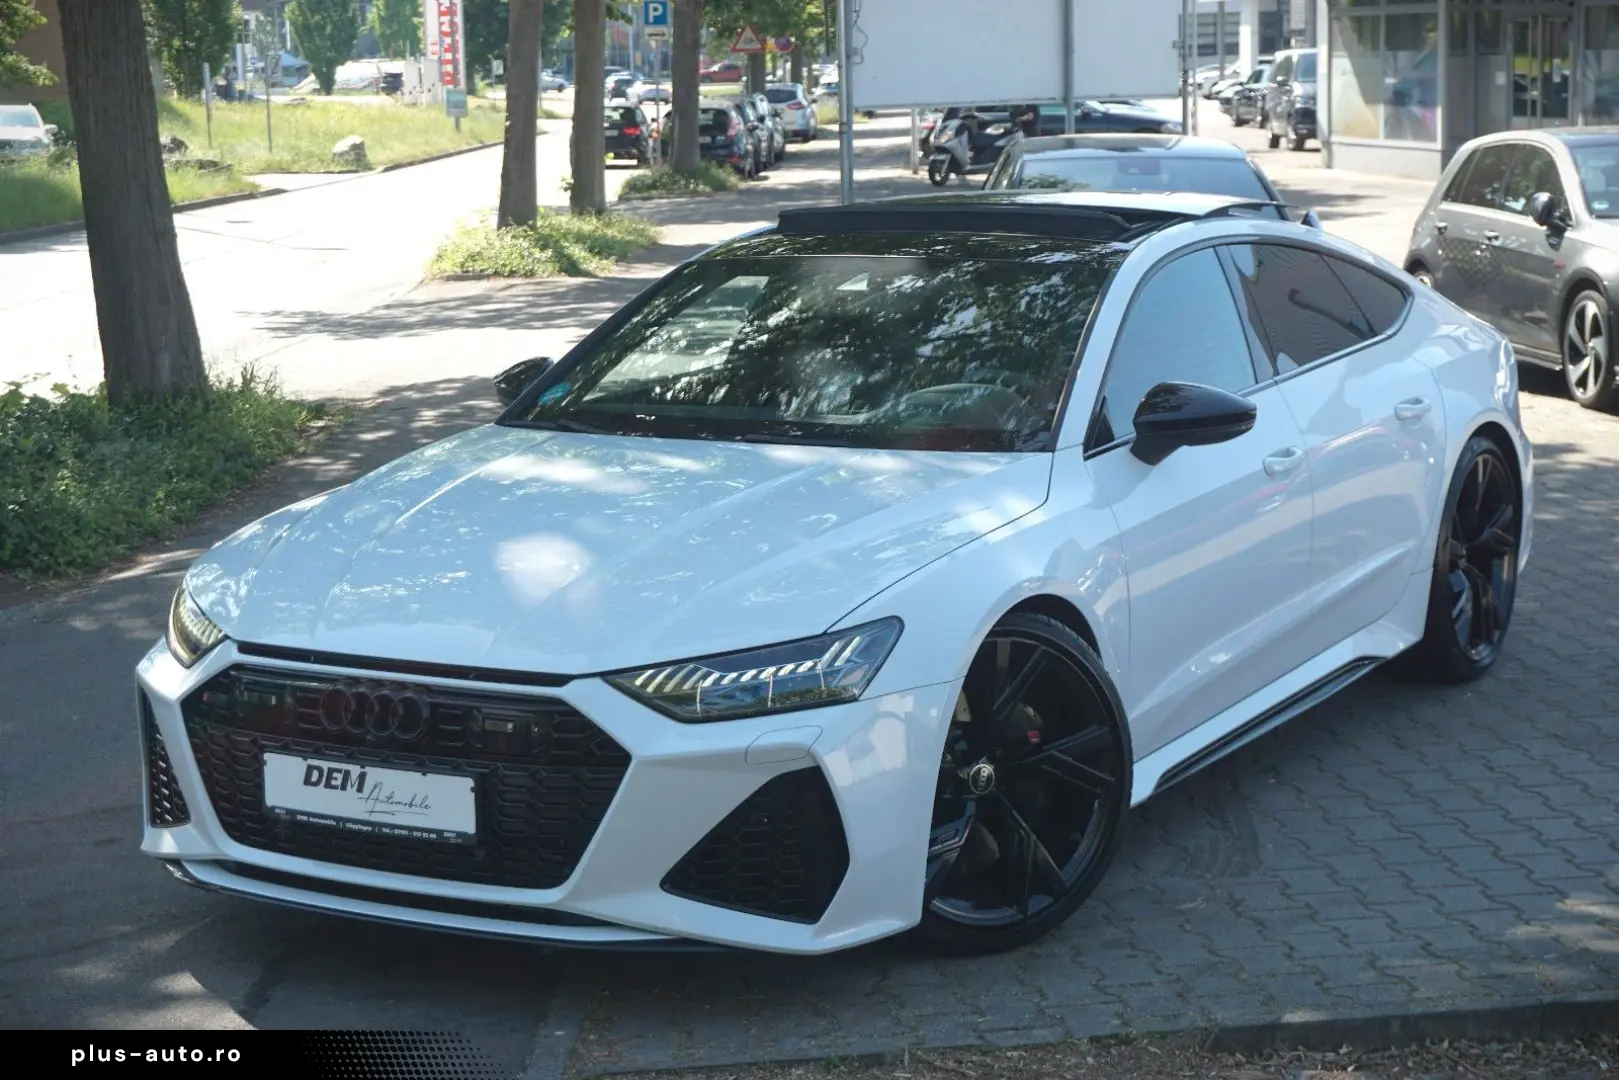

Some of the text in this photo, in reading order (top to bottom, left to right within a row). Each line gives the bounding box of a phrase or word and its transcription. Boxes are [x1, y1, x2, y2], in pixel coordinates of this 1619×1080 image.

[649, 3, 663, 23] P
[303, 763, 367, 794] DEM
[356, 780, 431, 817] Automobile
